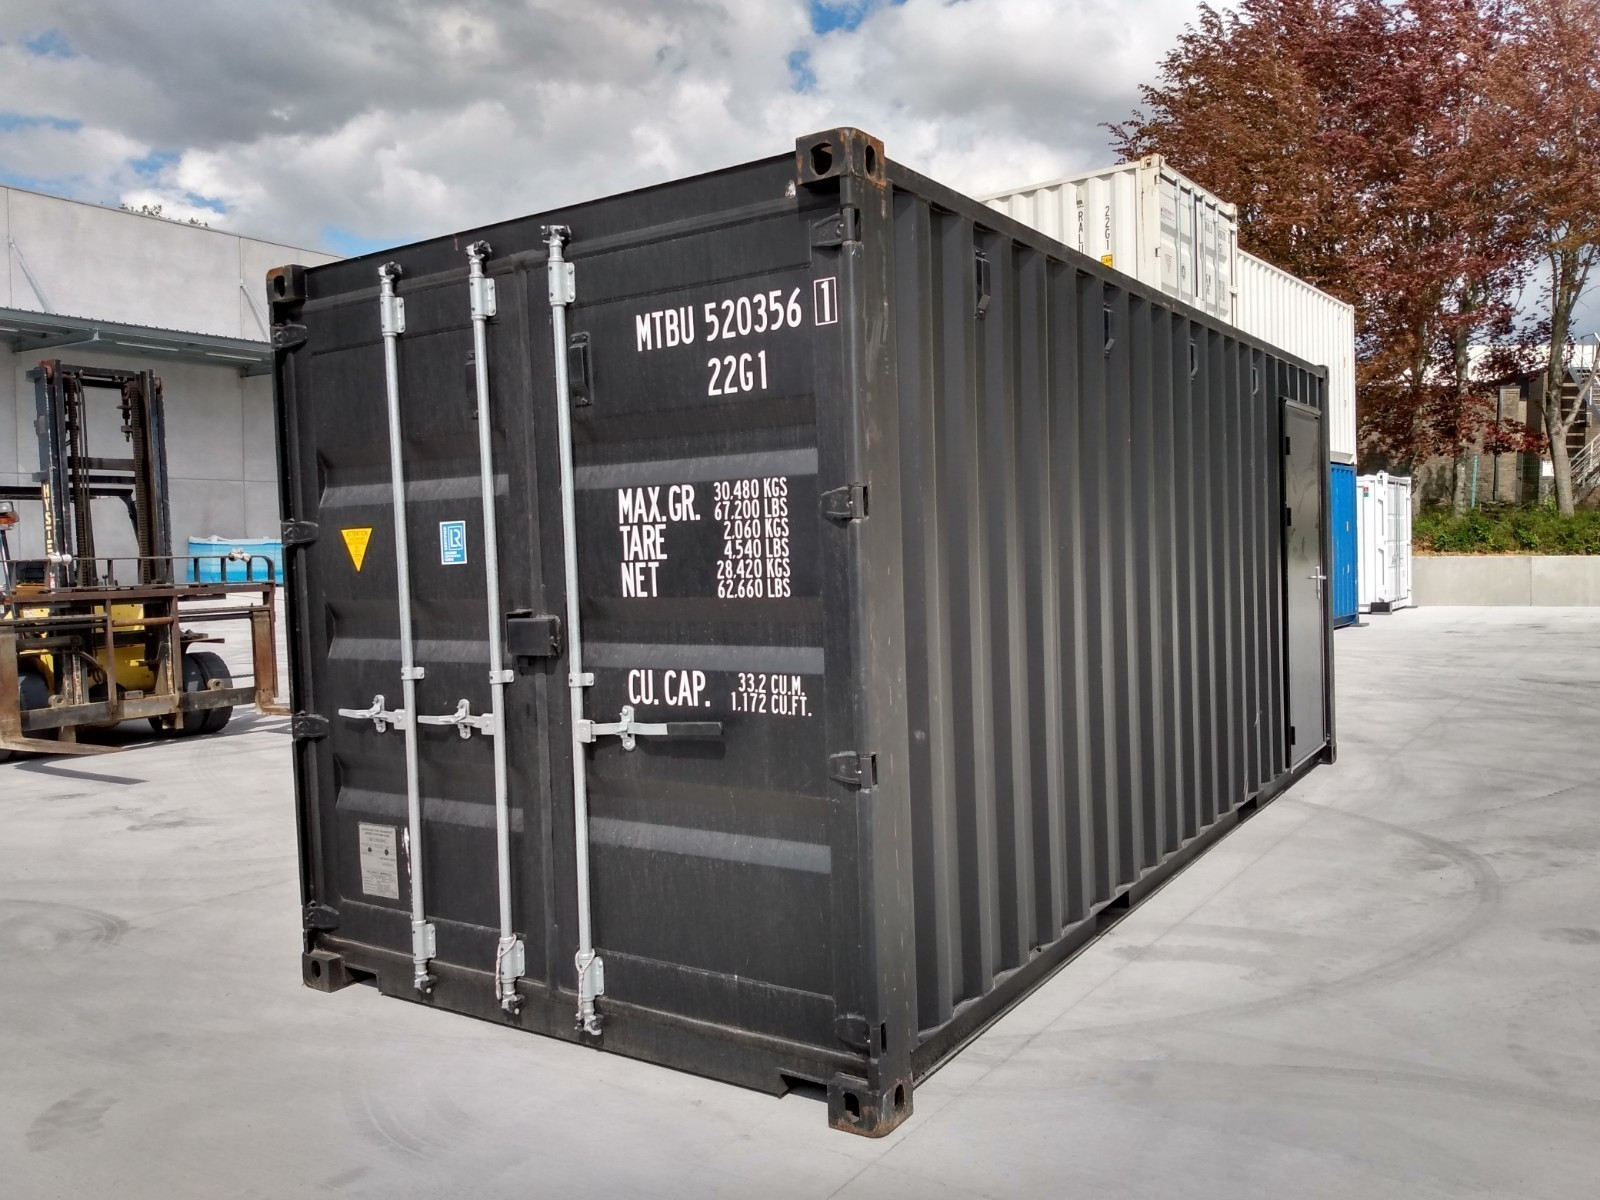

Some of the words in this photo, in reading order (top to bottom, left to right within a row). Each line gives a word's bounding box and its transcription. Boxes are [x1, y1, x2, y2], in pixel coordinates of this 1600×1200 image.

[635, 305, 695, 352] MTBU
[704, 286, 802, 342] 520356
[707, 350, 768, 397] 22G1
[713, 478, 759, 502] 30,480
[763, 476, 788, 498] KGS
[42, 483, 54, 554] HYSTE
[714, 499, 760, 521] 67,200
[764, 497, 788, 518] LBS
[619, 523, 668, 561] TARE
[723, 519, 761, 541] 2,060
[765, 517, 790, 538] KGS
[723, 538, 762, 560] 4,540
[765, 537, 790, 558] LBS
[620, 561, 660, 598] NET
[716, 559, 763, 580] 28,420
[766, 557, 791, 578] KGS
[717, 578, 763, 599] 62,660
[767, 577, 791, 598] LBS
[628, 669, 659, 706] CU.
[664, 670, 711, 708] CAP.
[738, 672, 767, 694] 33.2
[731, 691, 767, 714] 1,172
